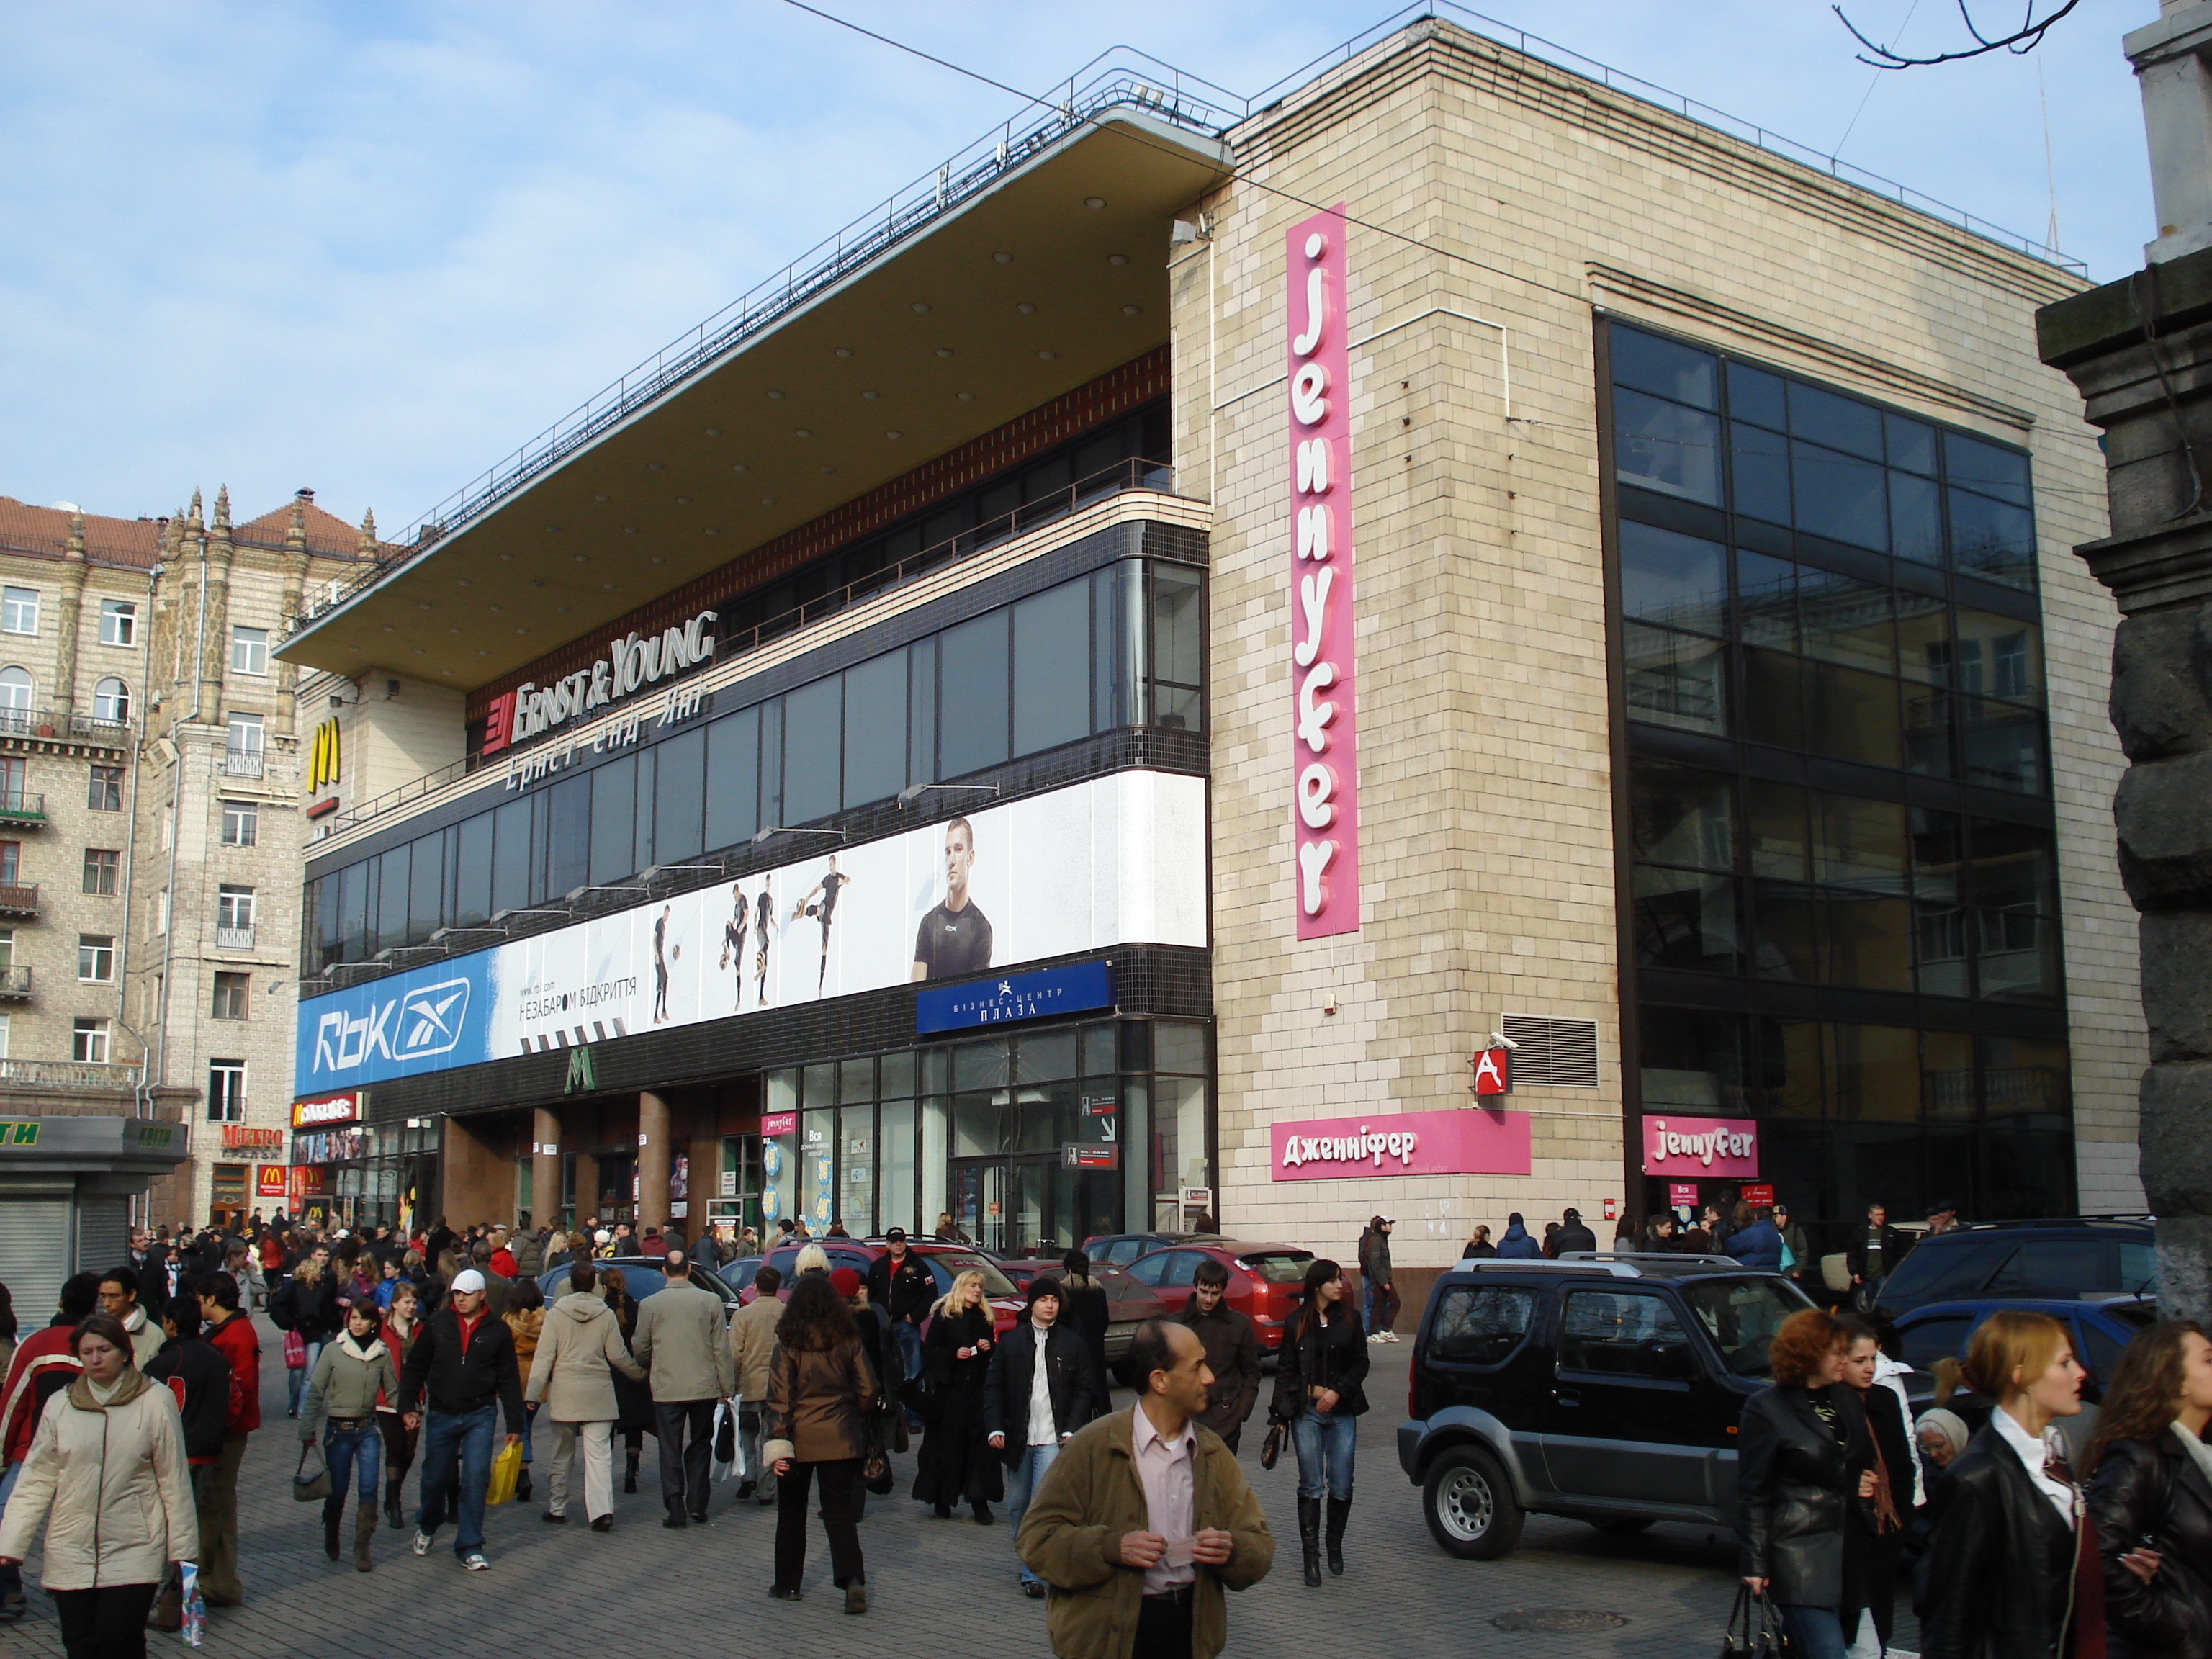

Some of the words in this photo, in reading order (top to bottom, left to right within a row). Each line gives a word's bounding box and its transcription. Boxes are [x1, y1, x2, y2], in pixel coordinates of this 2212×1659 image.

[1292, 233, 1338, 917] jennyfer
[511, 669, 591, 744] ERNST
[611, 610, 718, 697] YOUNG
[505, 736, 577, 792] Ернст
[593, 709, 641, 755] енд
[657, 680, 707, 729] Янг
[579, 976, 637, 1009] ВІДКРИТТЯ
[953, 988, 1063, 1013] БІЗНЕС-ЦЕНТР
[980, 1003, 1037, 1022] ПЛАЗА
[809, 1130, 822, 1142] Вся
[1282, 1124, 1417, 1167] Дженніфер
[1655, 1120, 1753, 1166] jennyfer
